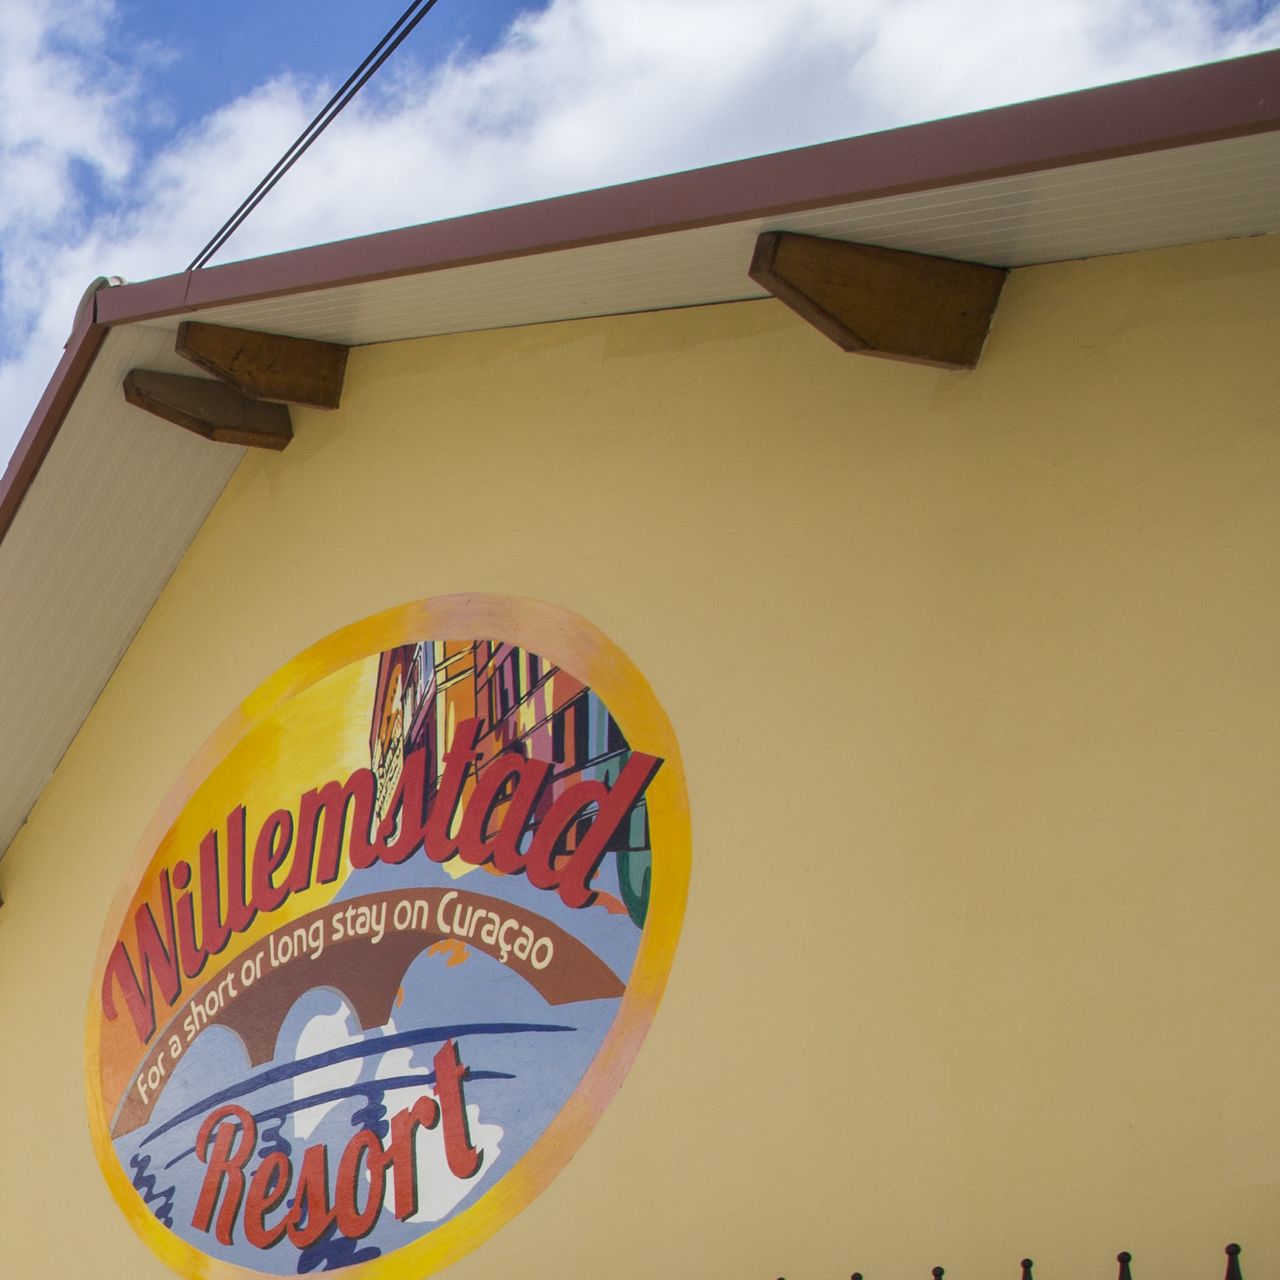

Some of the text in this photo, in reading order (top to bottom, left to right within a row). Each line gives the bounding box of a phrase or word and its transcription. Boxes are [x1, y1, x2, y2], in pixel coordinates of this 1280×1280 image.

[101, 718, 665, 1044] Willemstad
[168, 1034, 183, 1059] a
[183, 970, 238, 1042] short
[241, 951, 264, 987] or
[269, 919, 325, 968] long
[331, 901, 387, 944] stay
[393, 899, 429, 930] on
[436, 891, 554, 970] Curaçao
[191, 1039, 484, 1250] Resort
